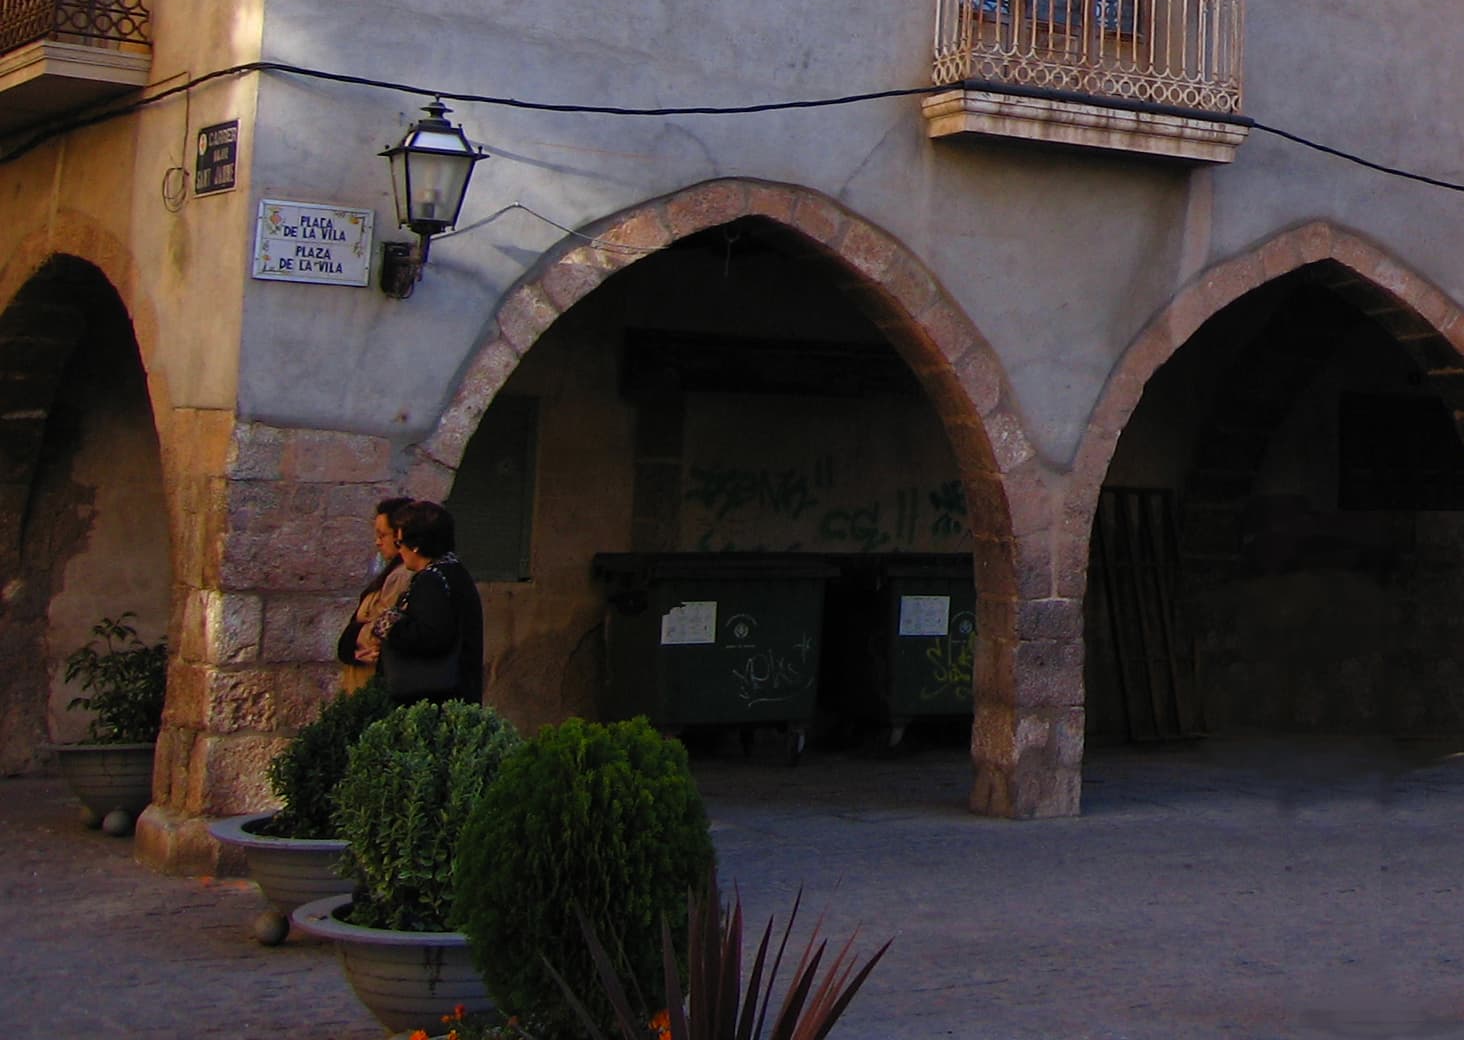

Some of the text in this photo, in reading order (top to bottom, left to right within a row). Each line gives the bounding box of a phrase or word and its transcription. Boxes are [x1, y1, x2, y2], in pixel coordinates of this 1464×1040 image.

[208, 127, 237, 146] CARRER
[283, 225, 346, 241] DE LA VILA
[295, 245, 331, 260] PLAZA
[279, 258, 343, 274] DE LA VILA
